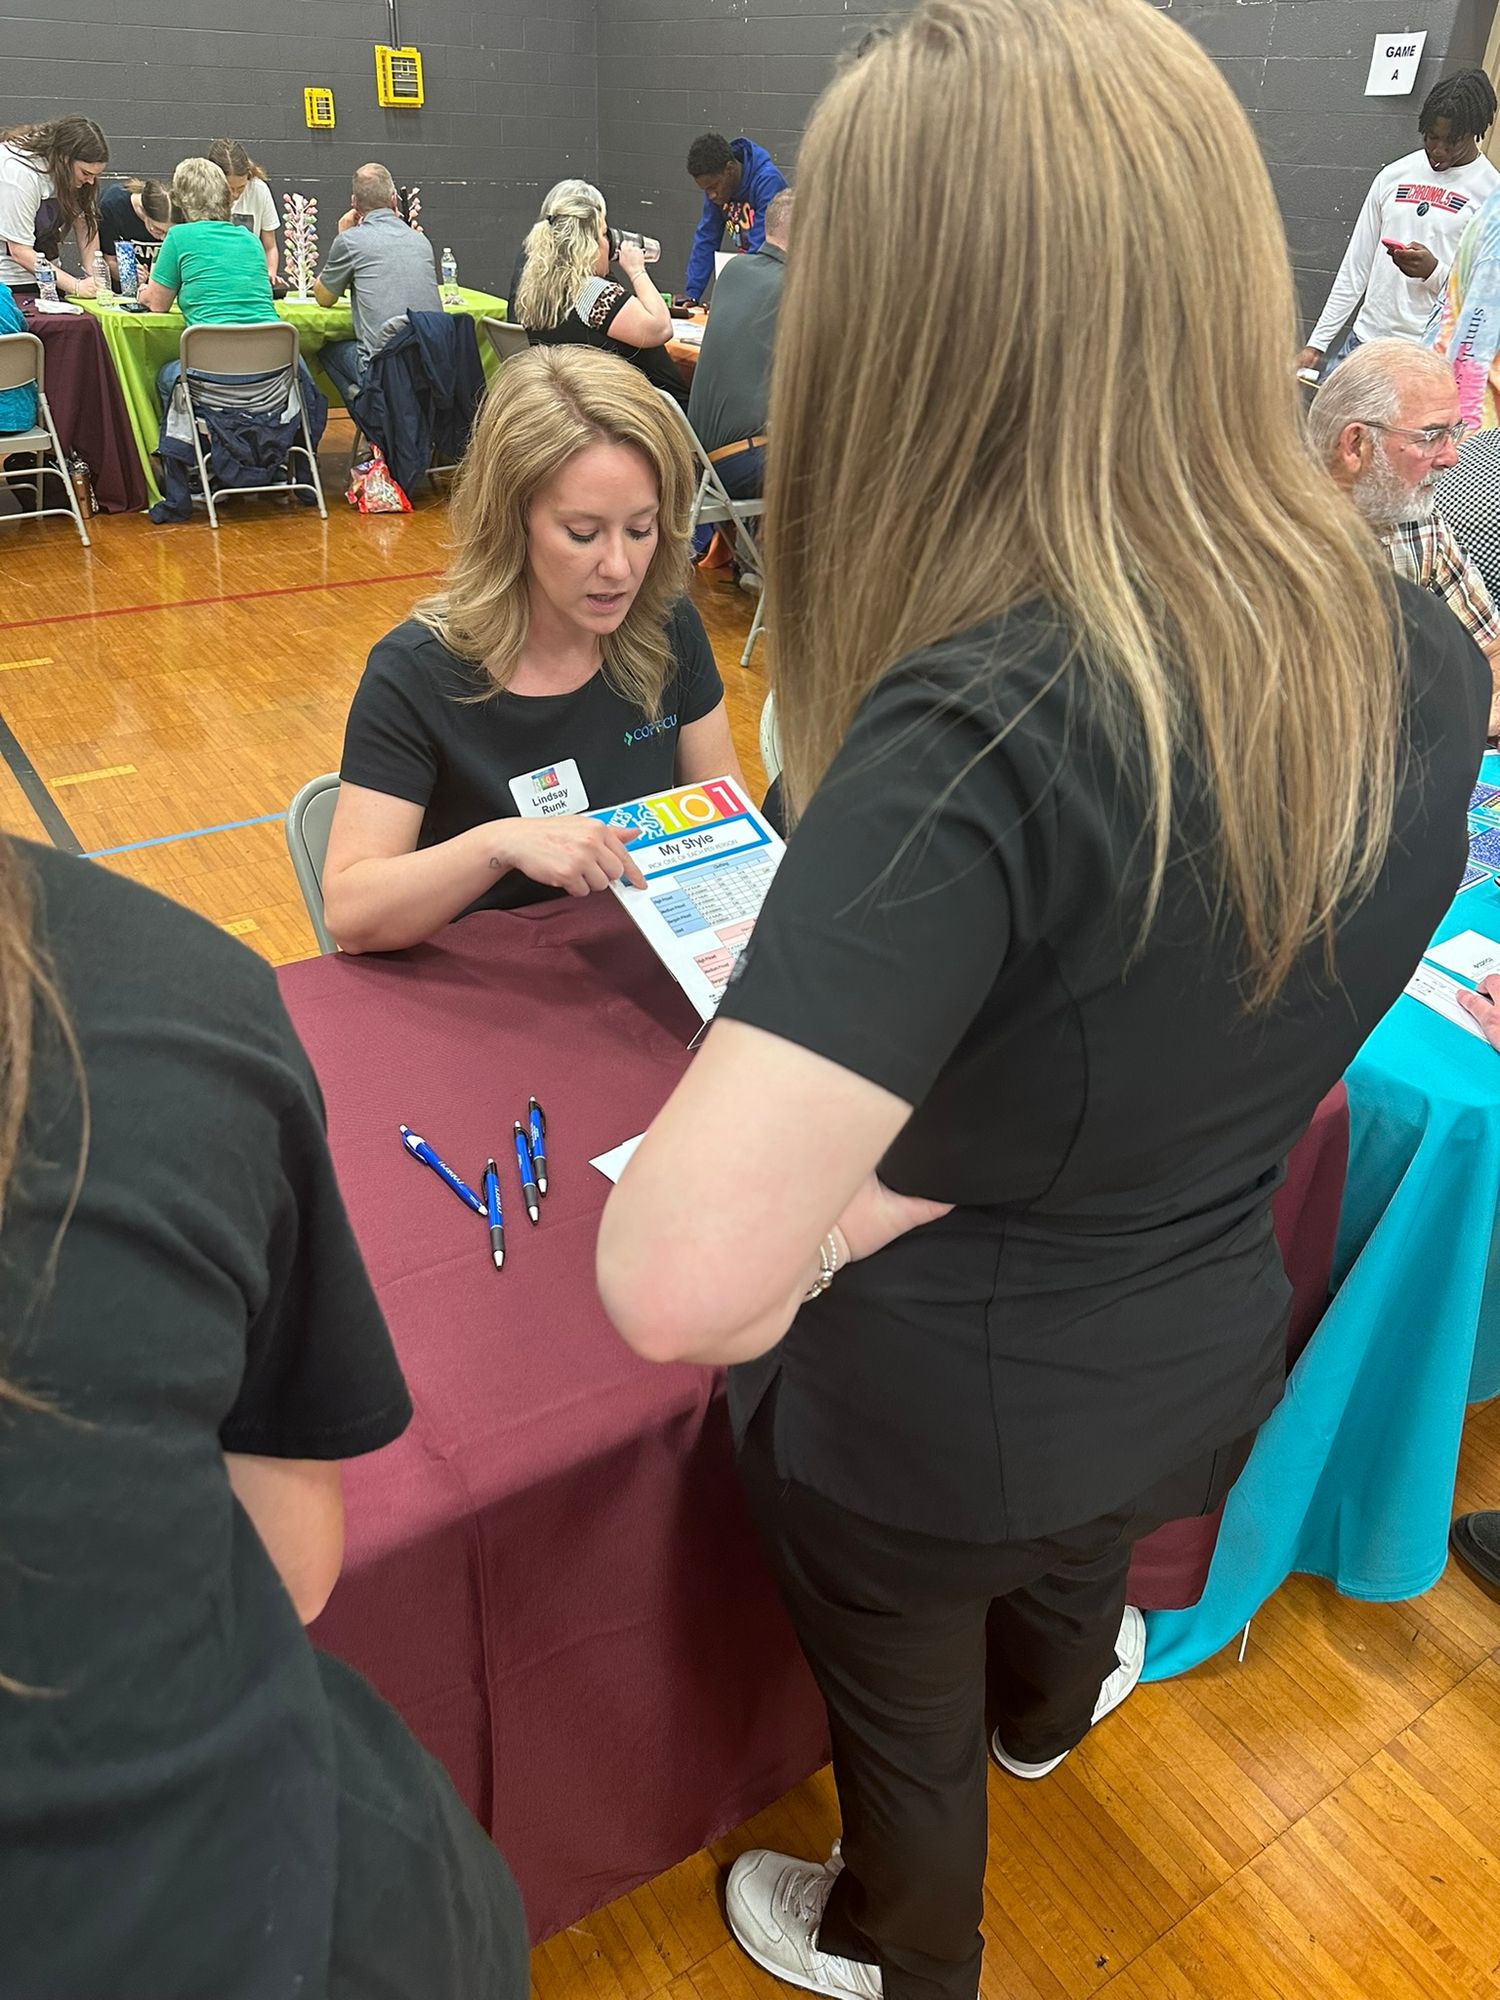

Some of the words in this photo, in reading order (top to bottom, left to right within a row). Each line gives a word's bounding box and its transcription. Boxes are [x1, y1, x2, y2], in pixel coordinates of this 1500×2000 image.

[1386, 45, 1416, 58] GAME
[1391, 69, 1399, 80] A
[1407, 184, 1452, 205] CARDINALS
[1456, 307, 1486, 364] simply
[531, 787, 569, 806] Lindsay
[541, 800, 567, 815] Runk
[656, 785, 739, 829] 101
[658, 842, 680, 858] My
[681, 832, 714, 850] Style
